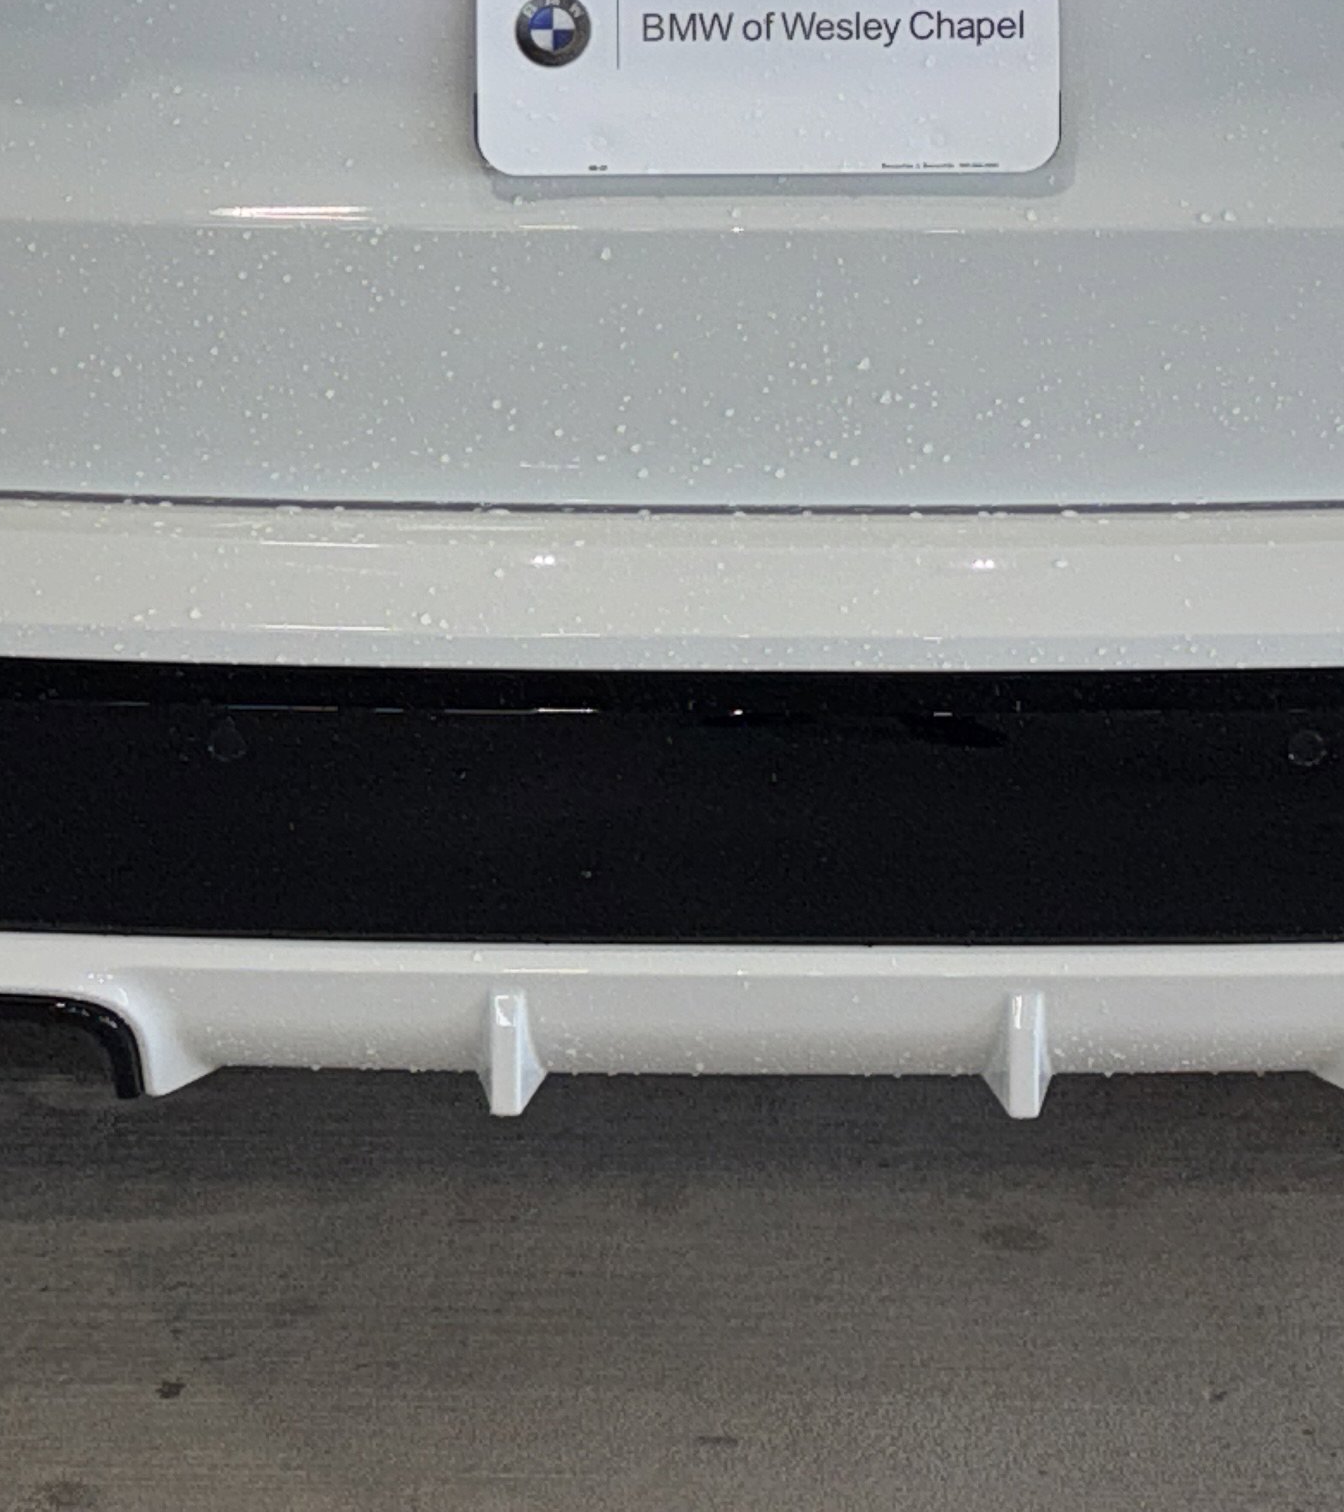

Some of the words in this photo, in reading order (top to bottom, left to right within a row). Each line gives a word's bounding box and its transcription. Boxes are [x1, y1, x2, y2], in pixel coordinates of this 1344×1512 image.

[641, 12, 735, 43] BMW
[742, 12, 776, 42] of
[783, 10, 901, 48] Wesley
[909, 9, 1026, 47] Chapel
